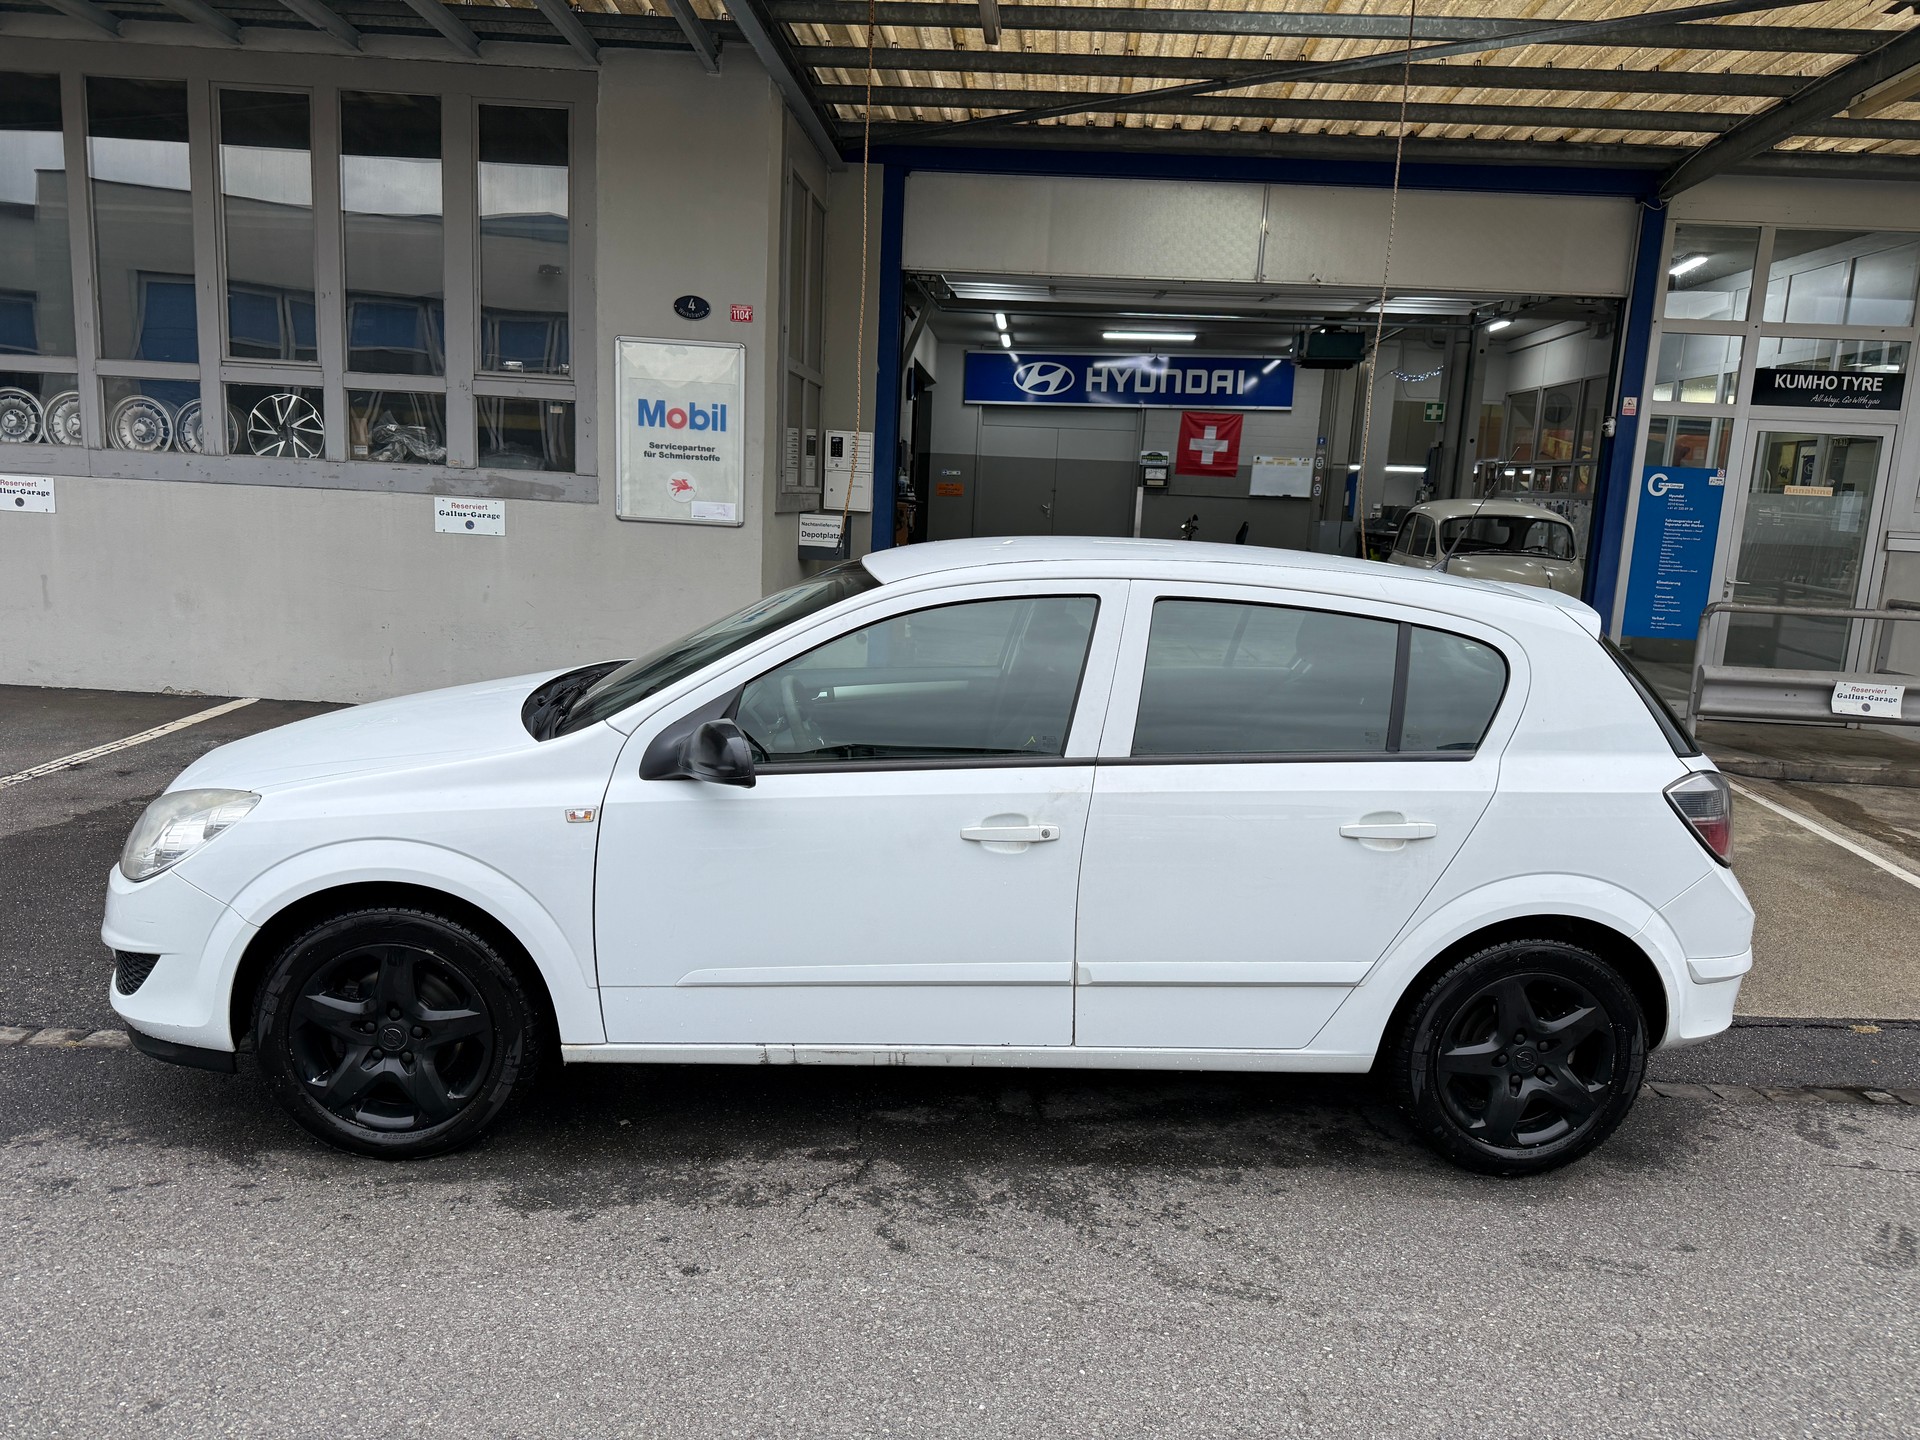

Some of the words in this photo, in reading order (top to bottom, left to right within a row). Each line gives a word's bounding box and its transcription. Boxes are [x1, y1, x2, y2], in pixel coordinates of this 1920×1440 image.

[688, 298, 696, 311] 4
[1086, 367, 1245, 395] HYUNDAI
[1774, 374, 1838, 390] KUMHO
[1841, 376, 1884, 392] TYRE
[638, 398, 727, 432] Mobil
[649, 441, 716, 452] Servicepartner
[643, 450, 657, 458] für
[658, 451, 721, 462] Schmierstoffe
[0, 479, 37, 487] Reserviert
[1785, 486, 1832, 496] Annahme
[451, 502, 488, 510] Reserviert
[438, 510, 501, 520] Gallus-Garage
[801, 530, 840, 540] Depotplatz
[1850, 686, 1888, 695] Reserviert
[1836, 692, 1898, 703] Gallus-Garage
